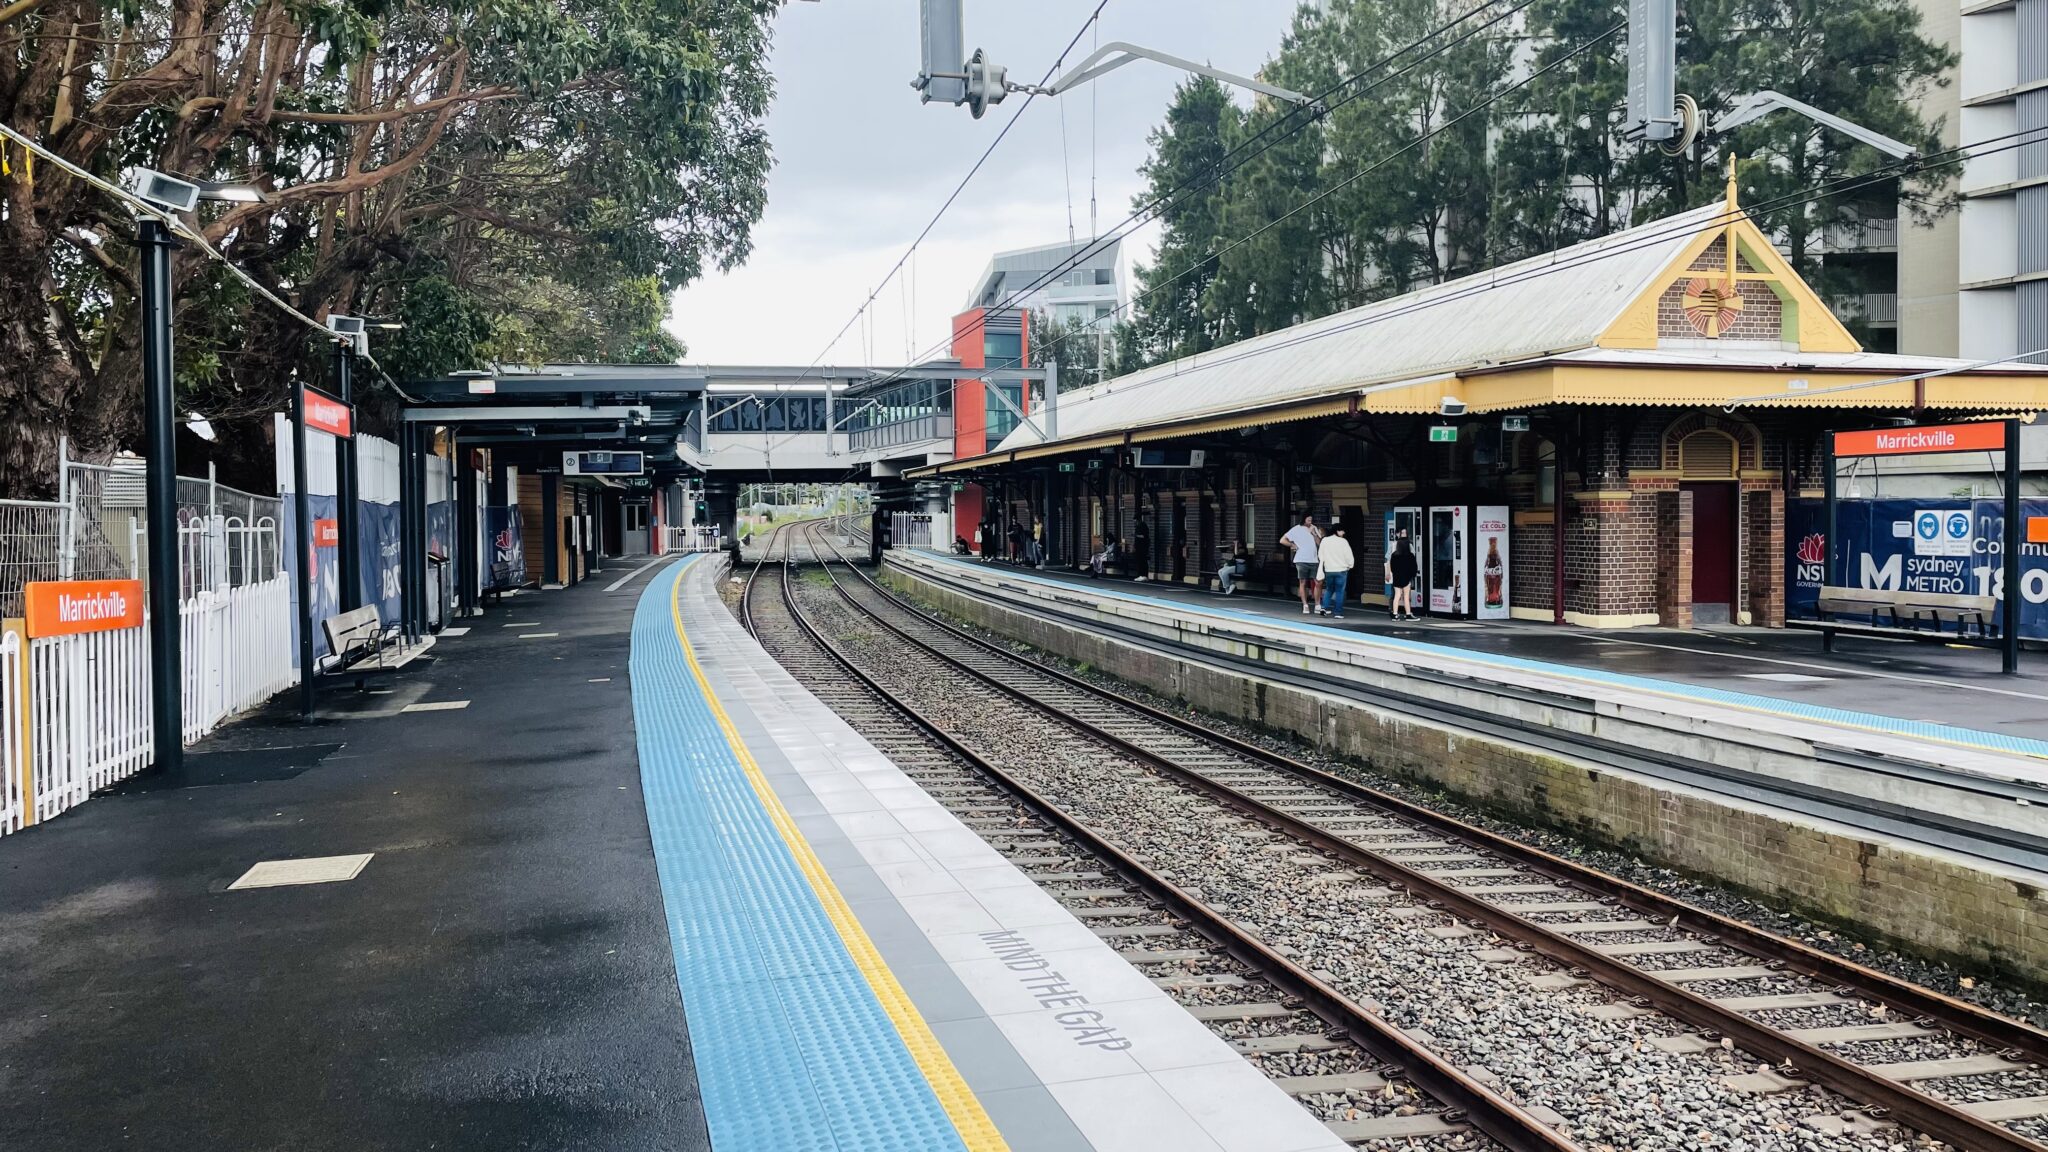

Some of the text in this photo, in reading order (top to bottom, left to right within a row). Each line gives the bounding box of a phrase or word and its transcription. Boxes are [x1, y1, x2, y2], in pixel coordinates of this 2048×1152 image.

[1876, 430, 1955, 449] Marrickville
[1125, 456, 1131, 464] 1
[1861, 553, 1902, 591] M
[1907, 556, 1964, 576] sydney
[1906, 576, 1964, 593] METRO
[59, 591, 126, 622] Marrickville
[978, 930, 1132, 1051] MIND THE GAP
